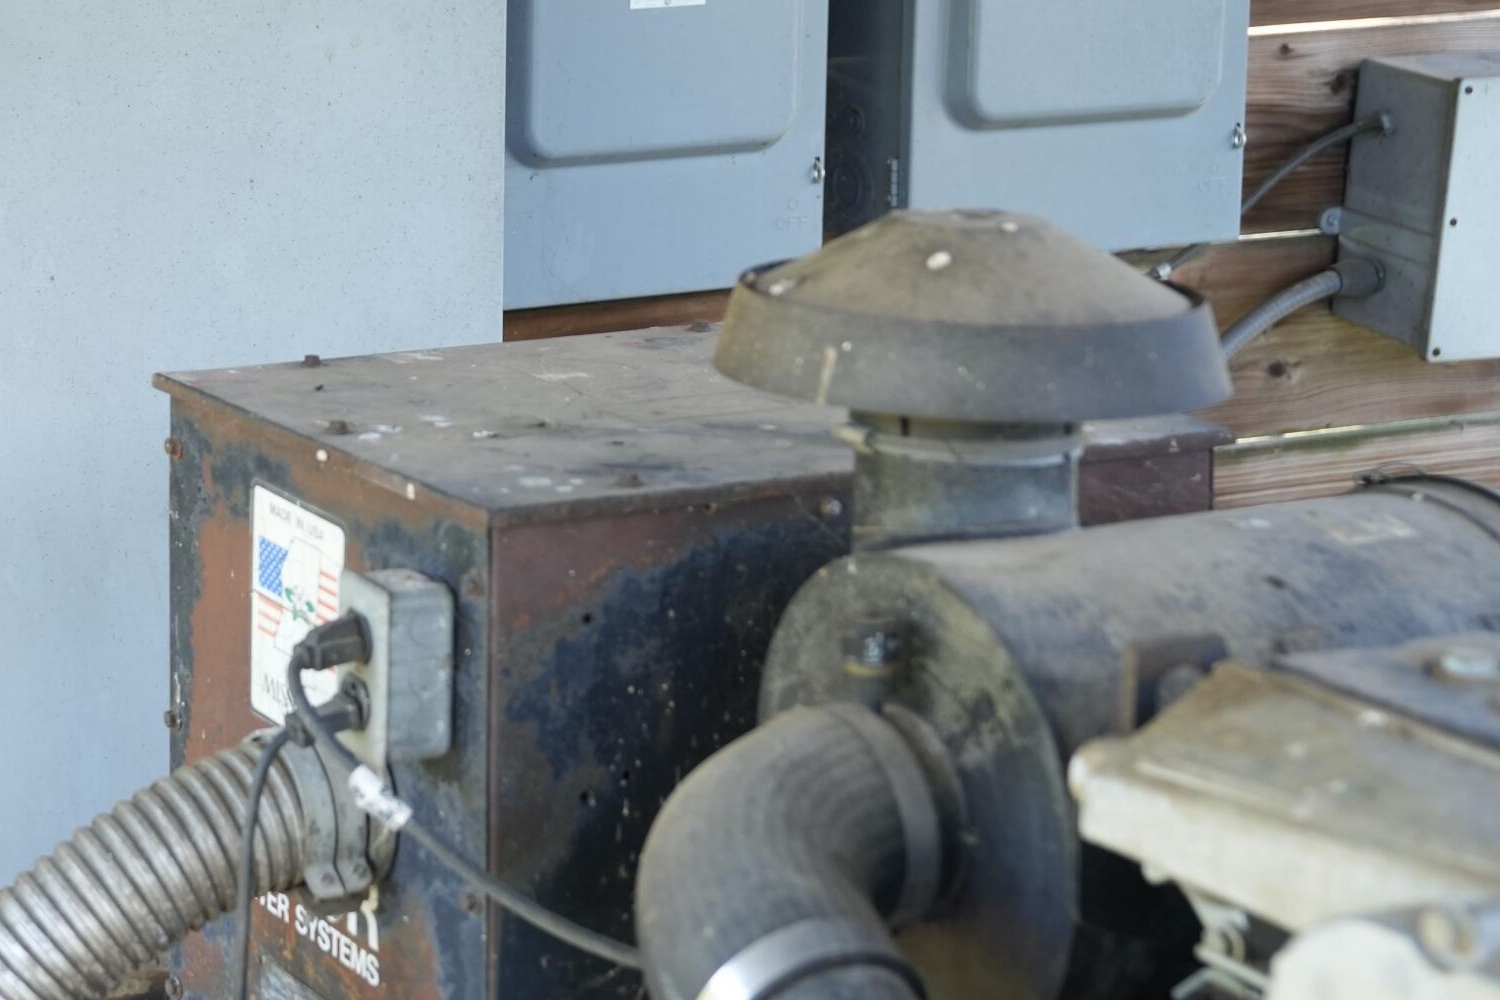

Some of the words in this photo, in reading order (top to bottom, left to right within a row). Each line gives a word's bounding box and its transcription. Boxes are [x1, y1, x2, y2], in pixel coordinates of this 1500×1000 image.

[268, 503, 292, 525] MADE
[295, 514, 305, 530] IN
[294, 903, 381, 988] SYSTEMS
